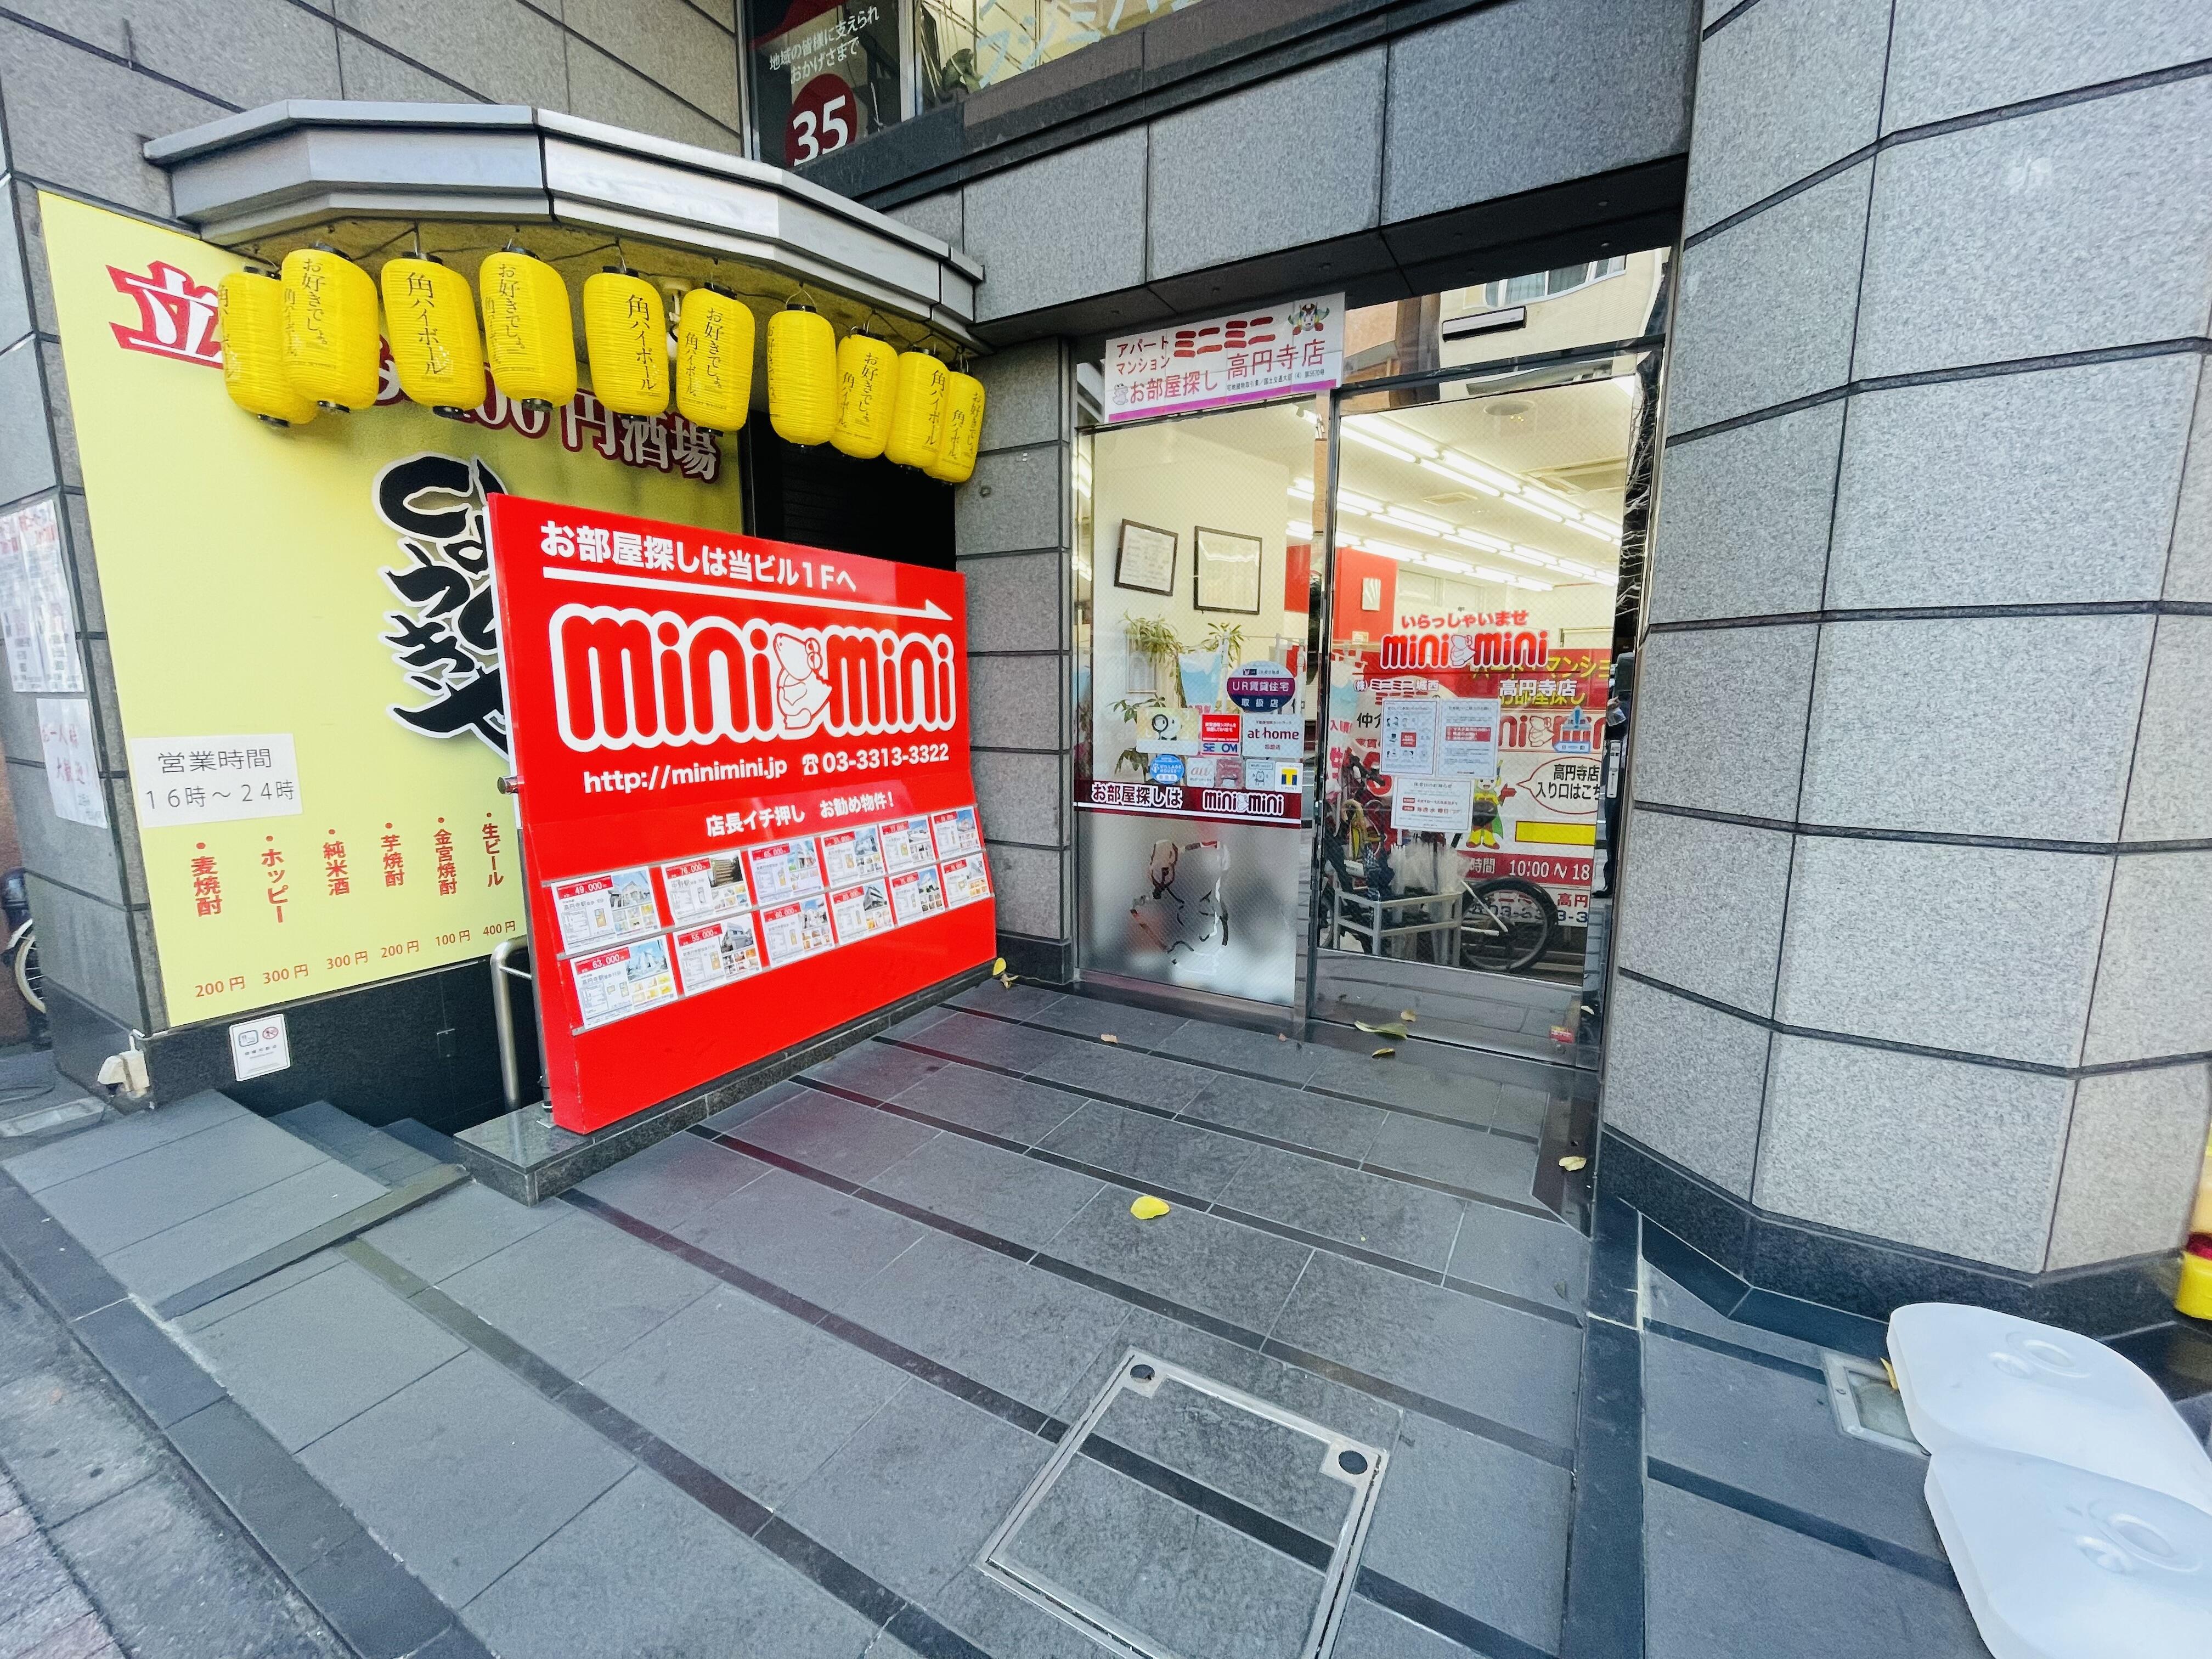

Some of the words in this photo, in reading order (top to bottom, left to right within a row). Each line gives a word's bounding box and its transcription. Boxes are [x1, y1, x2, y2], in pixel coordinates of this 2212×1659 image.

[769, 5, 879, 71] 地域の皆様に支えられ
[791, 36, 860, 84] おかげさまで
[793, 95, 848, 166] 35
[407, 272, 448, 375] 角ハイボール
[625, 294, 657, 391] 角ハイボール
[1173, 316, 1276, 358] ミニミニ
[1116, 335, 1169, 358] アパート
[1116, 356, 1170, 376] マンション
[1227, 338, 1326, 381] 高円寺店
[925, 369, 946, 445] 角ハイボール
[1130, 370, 1218, 404] お部屋探し
[540, 520, 857, 592] お部屋探しは当ビル1Fへ
[1401, 610, 1530, 629] いらっしゃいませ
[1380, 633, 1451, 670] mini
[1471, 629, 1550, 668] mini
[1232, 681, 1290, 692] UR賃貸住宅
[1499, 679, 1578, 698] 高円寺店
[1203, 743, 1238, 753] SEOM
[1247, 729, 1261, 739] at
[1262, 727, 1299, 740] home
[158, 748, 272, 774] 営業時間
[583, 755, 788, 795] http://minimini.jp
[822, 743, 949, 775] 03-3313-3322
[1553, 764, 1600, 782] 高円寺店
[705, 802, 806, 838] 店長イチ押し
[820, 792, 895, 819] お勧め物件!
[1091, 782, 1183, 809] お部屋探しは
[1202, 789, 1237, 813] mini
[1248, 792, 1284, 816] mini
[323, 840, 351, 896] 純米酒
[380, 834, 405, 888] 芋焼酎
[433, 828, 458, 896] 金宮焼酎
[482, 822, 504, 888] 生ビール
[191, 856, 223, 917] 麦焼酎
[261, 848, 289, 923] ホッピー
